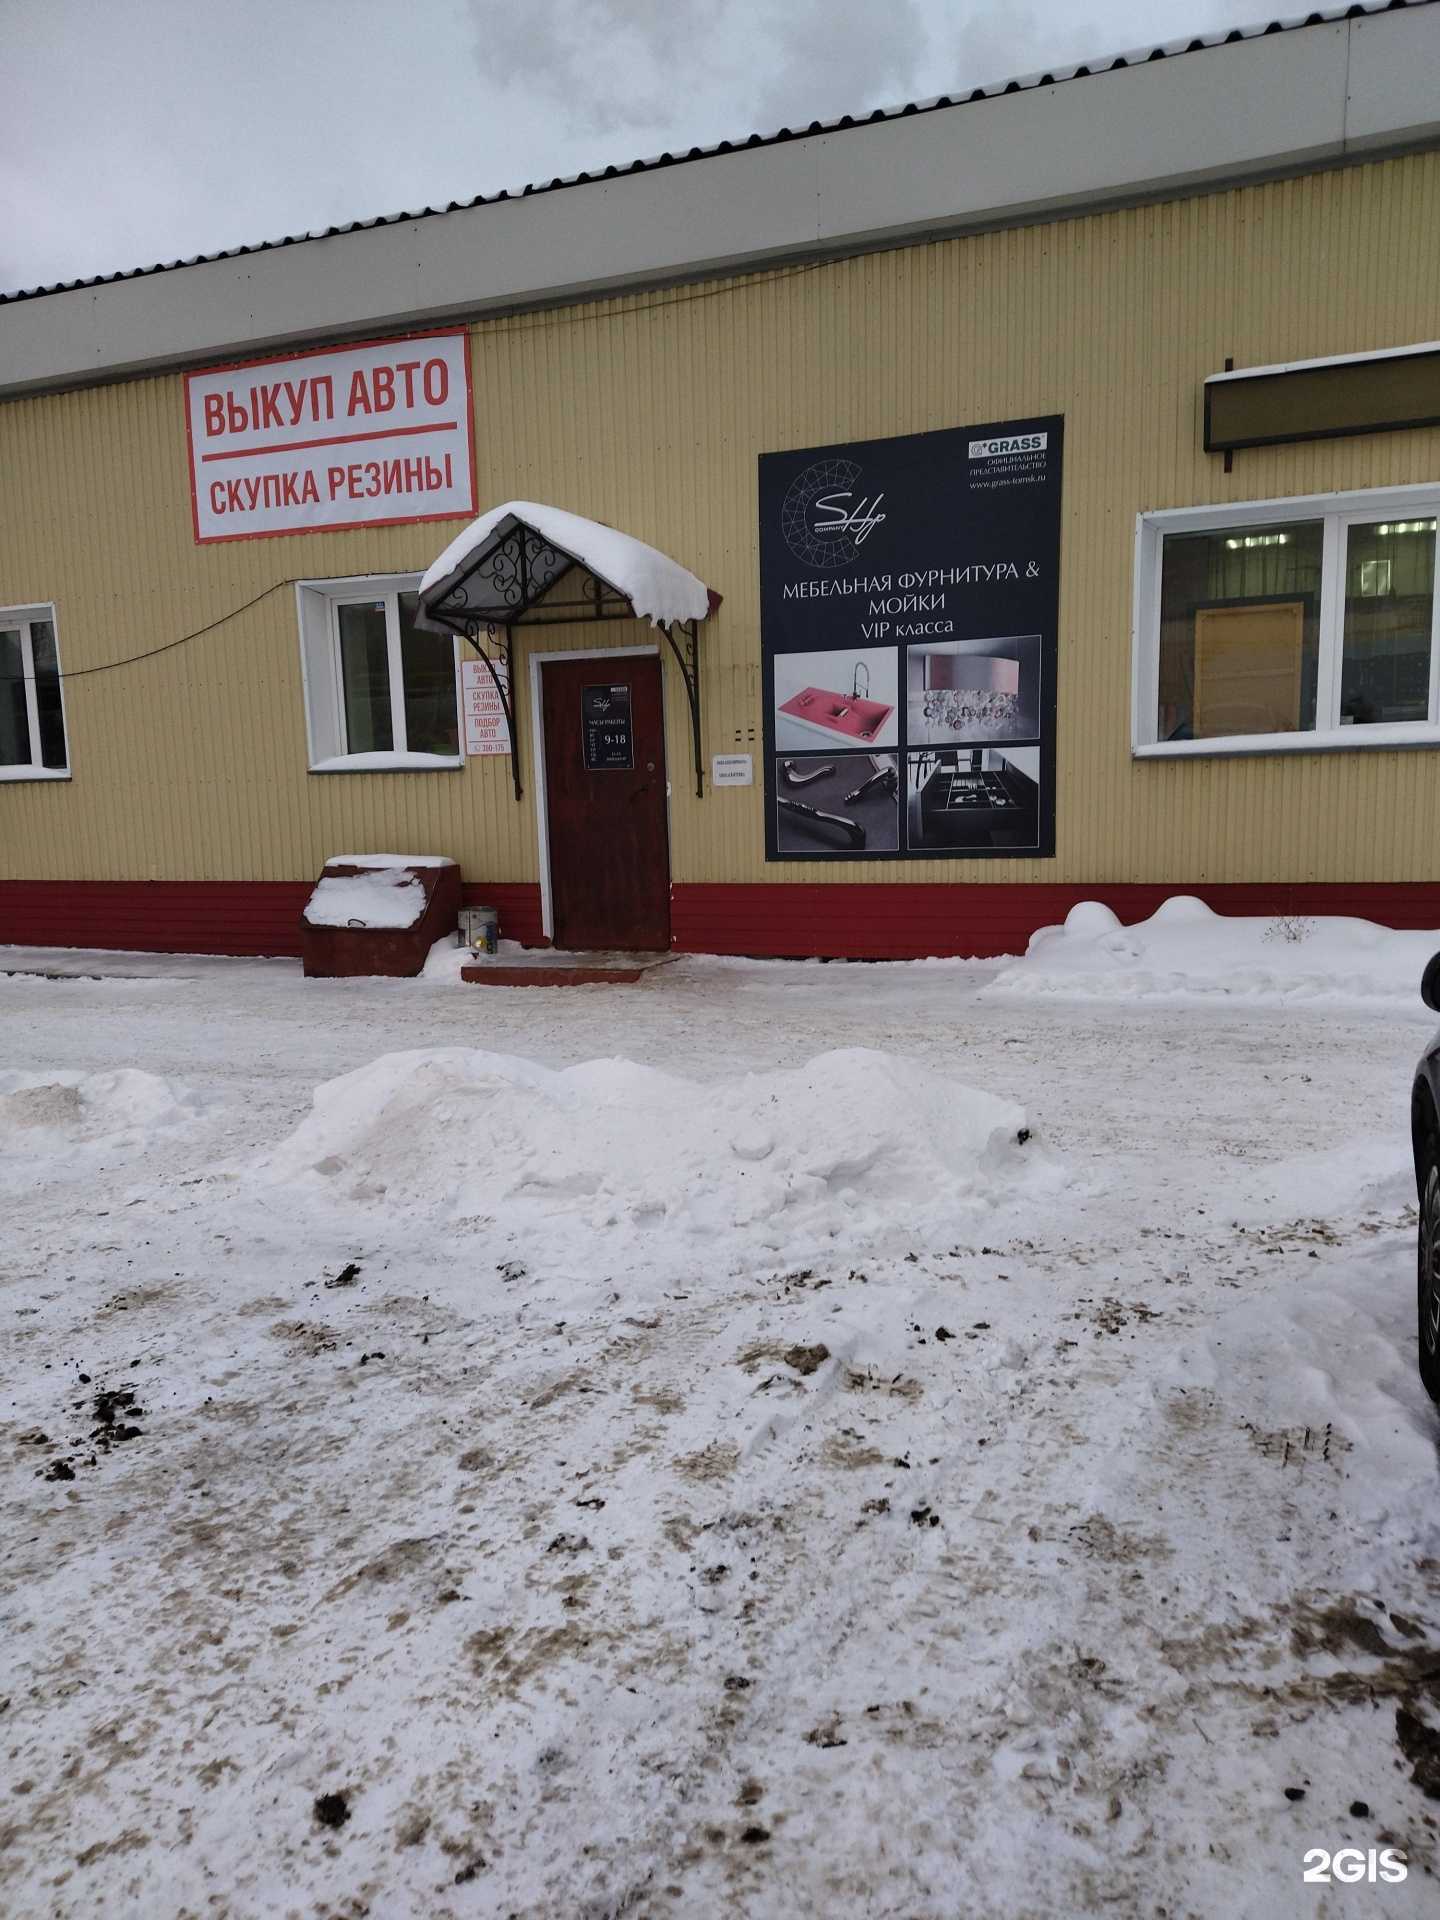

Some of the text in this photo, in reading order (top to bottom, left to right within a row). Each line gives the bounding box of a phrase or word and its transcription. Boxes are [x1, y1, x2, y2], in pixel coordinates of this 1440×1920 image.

[204, 358, 449, 437] ВЫКУП АВТО
[988, 436, 1042, 454] GRASS
[987, 452, 1046, 466] ОФИЦИАЛЬНОЕ
[969, 461, 1047, 477] ПРЕДСТАВИТЕЛЬСТВО
[209, 453, 453, 515] СКУПКА РЕЗИНЫ
[969, 474, 1046, 489] www.grass-tomsk.ru
[783, 560, 1040, 600] МЕБЕЛЬНАЯ ФУРНИТУРА &
[868, 593, 945, 616] МОЙКИ
[860, 619, 954, 639] VIP класса
[476, 675, 493, 684] АВТО
[472, 691, 499, 701] СКУПКА
[473, 702, 500, 712] РЕЗИНЫ
[474, 718, 500, 728] ПОДБОР
[480, 728, 496, 738] АВТО
[604, 734, 626, 744] 9-18
